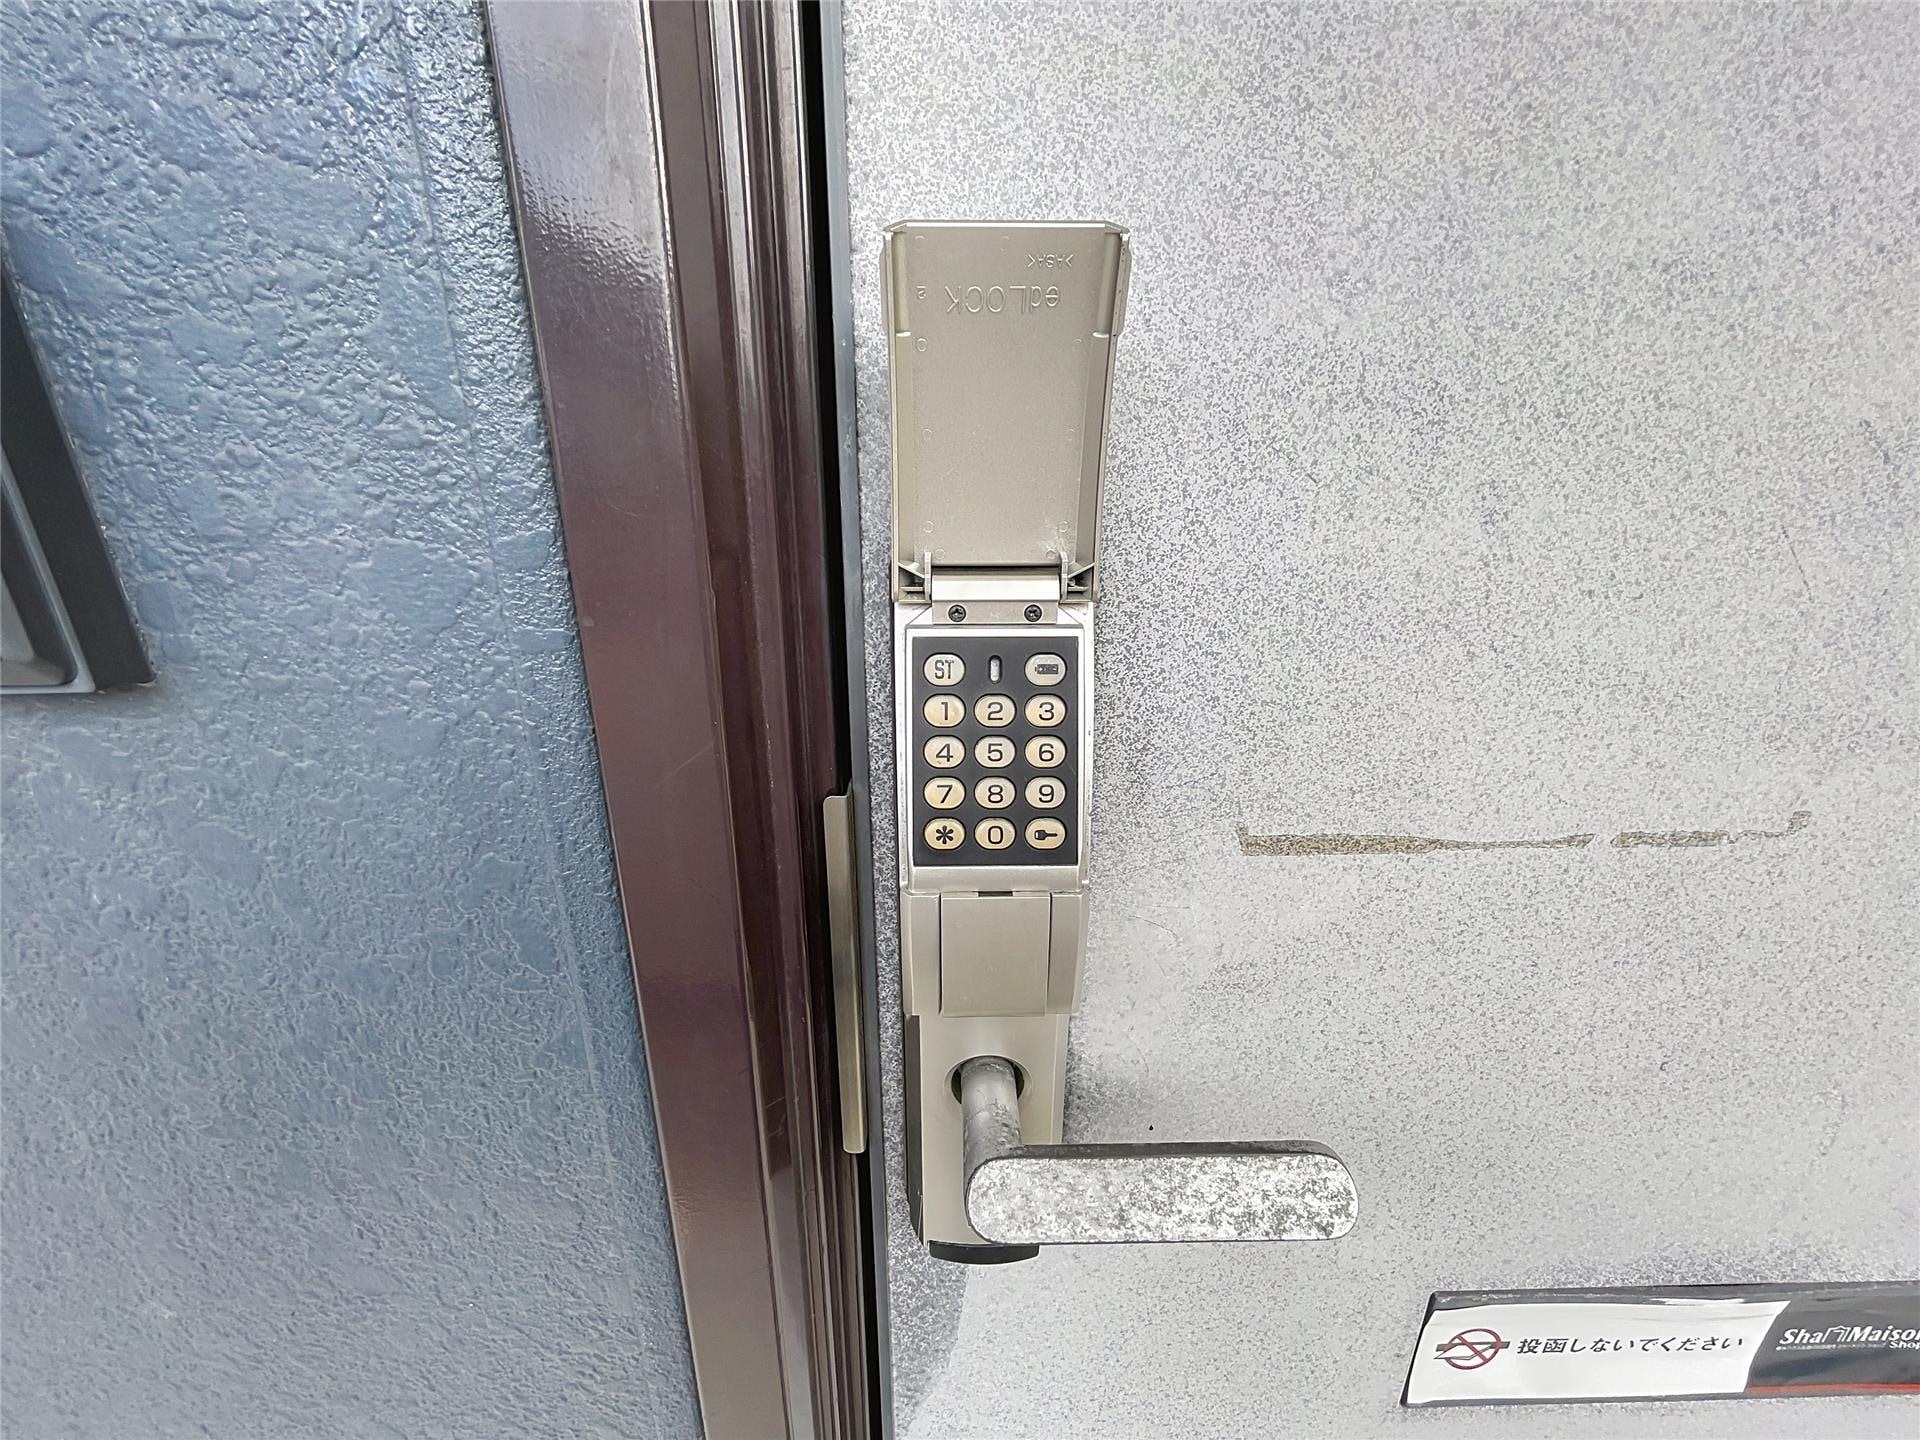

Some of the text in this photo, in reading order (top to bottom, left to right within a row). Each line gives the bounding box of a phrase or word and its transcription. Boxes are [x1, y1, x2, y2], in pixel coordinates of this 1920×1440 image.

[944, 285, 1061, 314] edLOCK
[934, 659, 955, 680] ST
[940, 701, 1055, 721] 1 2 3
[935, 743, 1055, 762] 4 5 6
[936, 784, 1055, 804] 7 8 9
[987, 825, 1004, 844] 0
[1516, 1336, 1743, 1354] 投函しないでください
